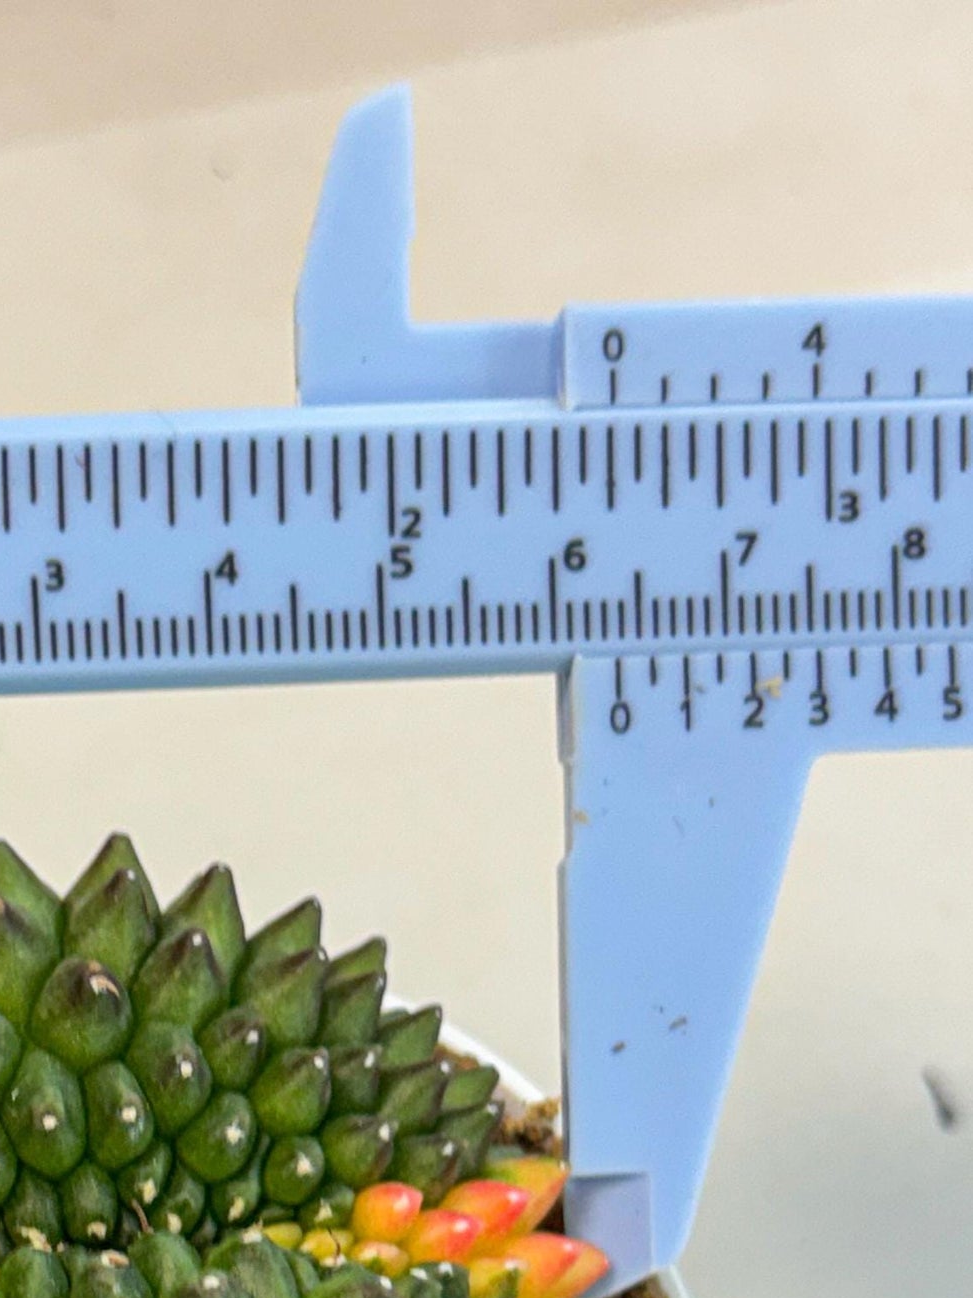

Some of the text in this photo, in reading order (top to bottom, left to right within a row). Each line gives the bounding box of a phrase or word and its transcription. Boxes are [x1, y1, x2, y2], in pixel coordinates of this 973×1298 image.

[602, 321, 826, 363] 0 4
[400, 506, 422, 539] 2
[837, 490, 860, 523] 3
[44, 558, 66, 592] 3
[214, 549, 238, 587] 4
[389, 545, 414, 579] 5
[562, 537, 587, 572] 6
[734, 530, 759, 567] 7
[902, 526, 927, 560] 8
[609, 685, 965, 734] 0 1 2 3 4 5
